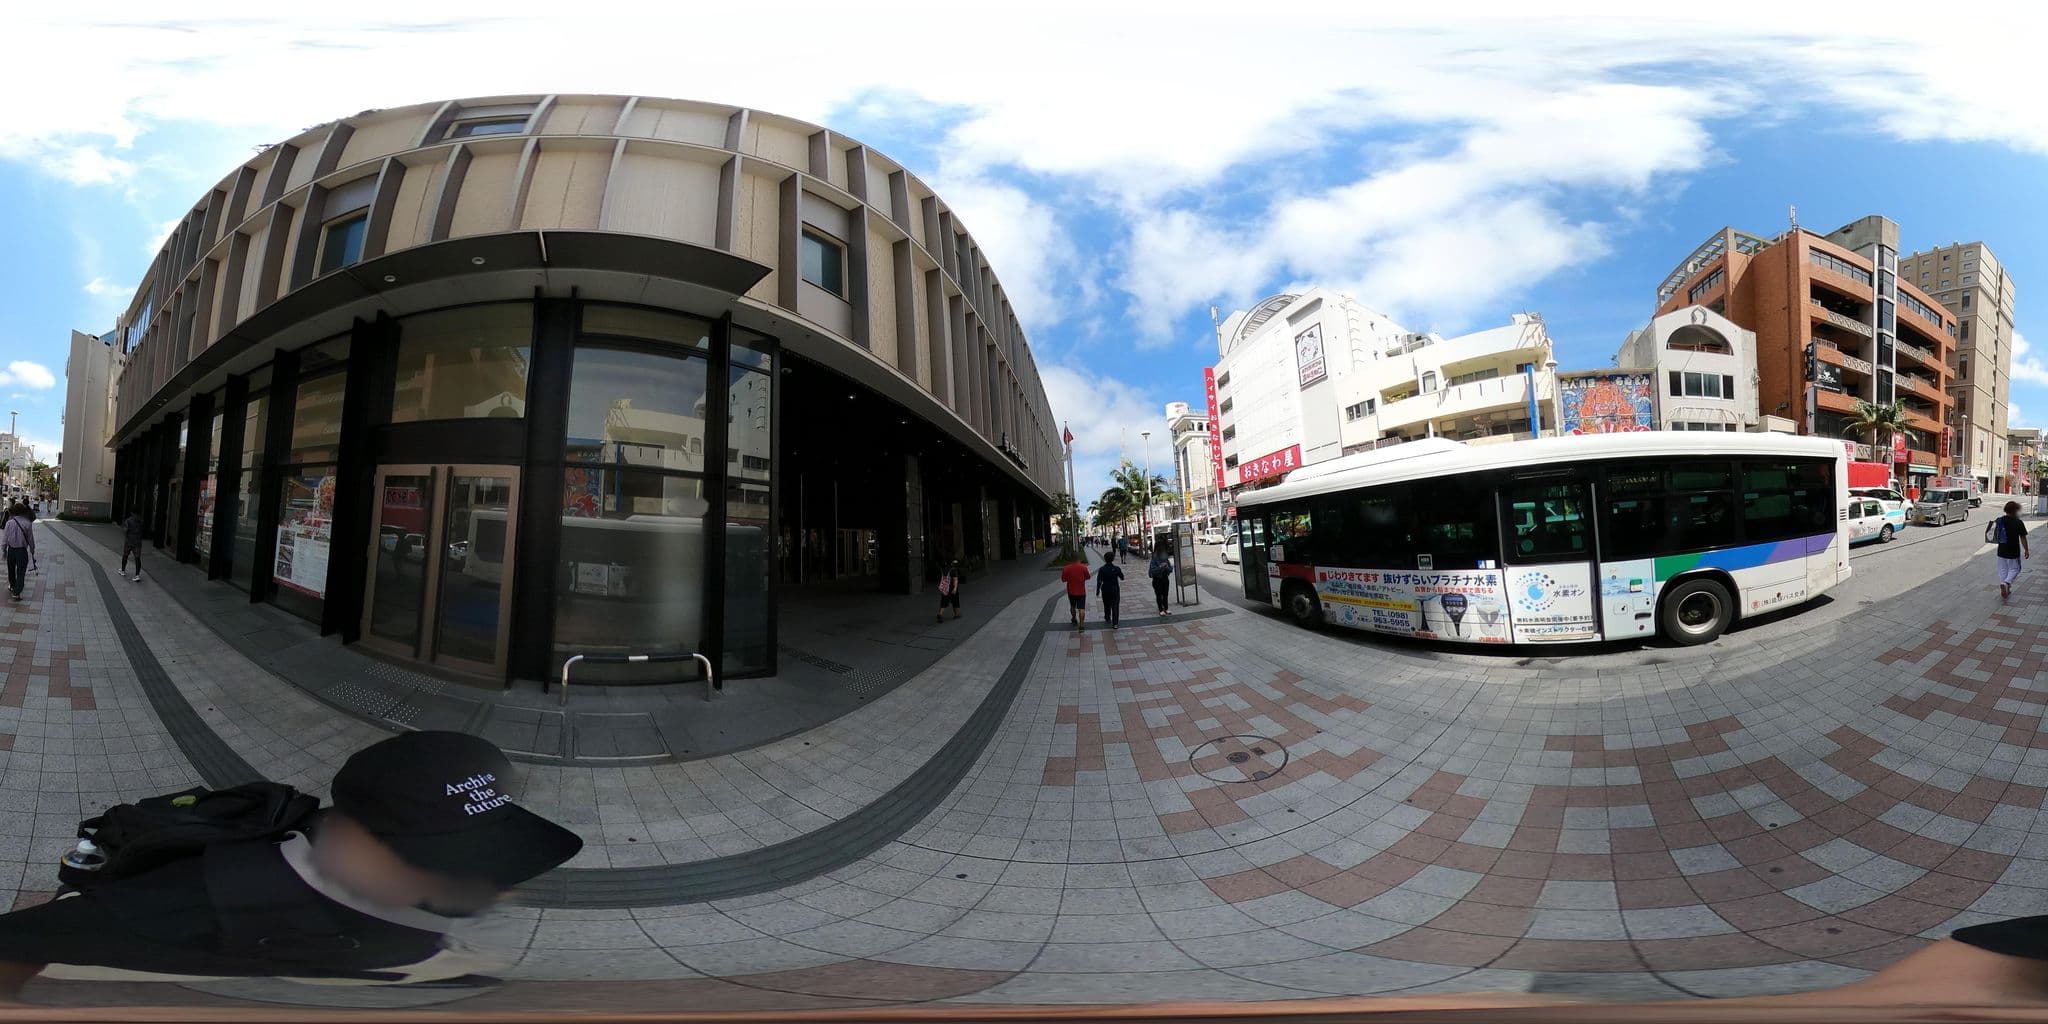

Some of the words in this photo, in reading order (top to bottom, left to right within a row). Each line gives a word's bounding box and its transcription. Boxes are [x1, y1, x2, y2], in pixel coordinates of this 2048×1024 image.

[1206, 376, 1221, 470] ハイサイおきなわビル
[1244, 449, 1294, 479] おきなわ屋
[1383, 573, 1497, 586] 抜けずらいプラチナ水素
[1552, 589, 1585, 598] 水素オン
[1374, 617, 1412, 628] 963-5955
[469, 788, 496, 802] the
[464, 794, 512, 815] future
